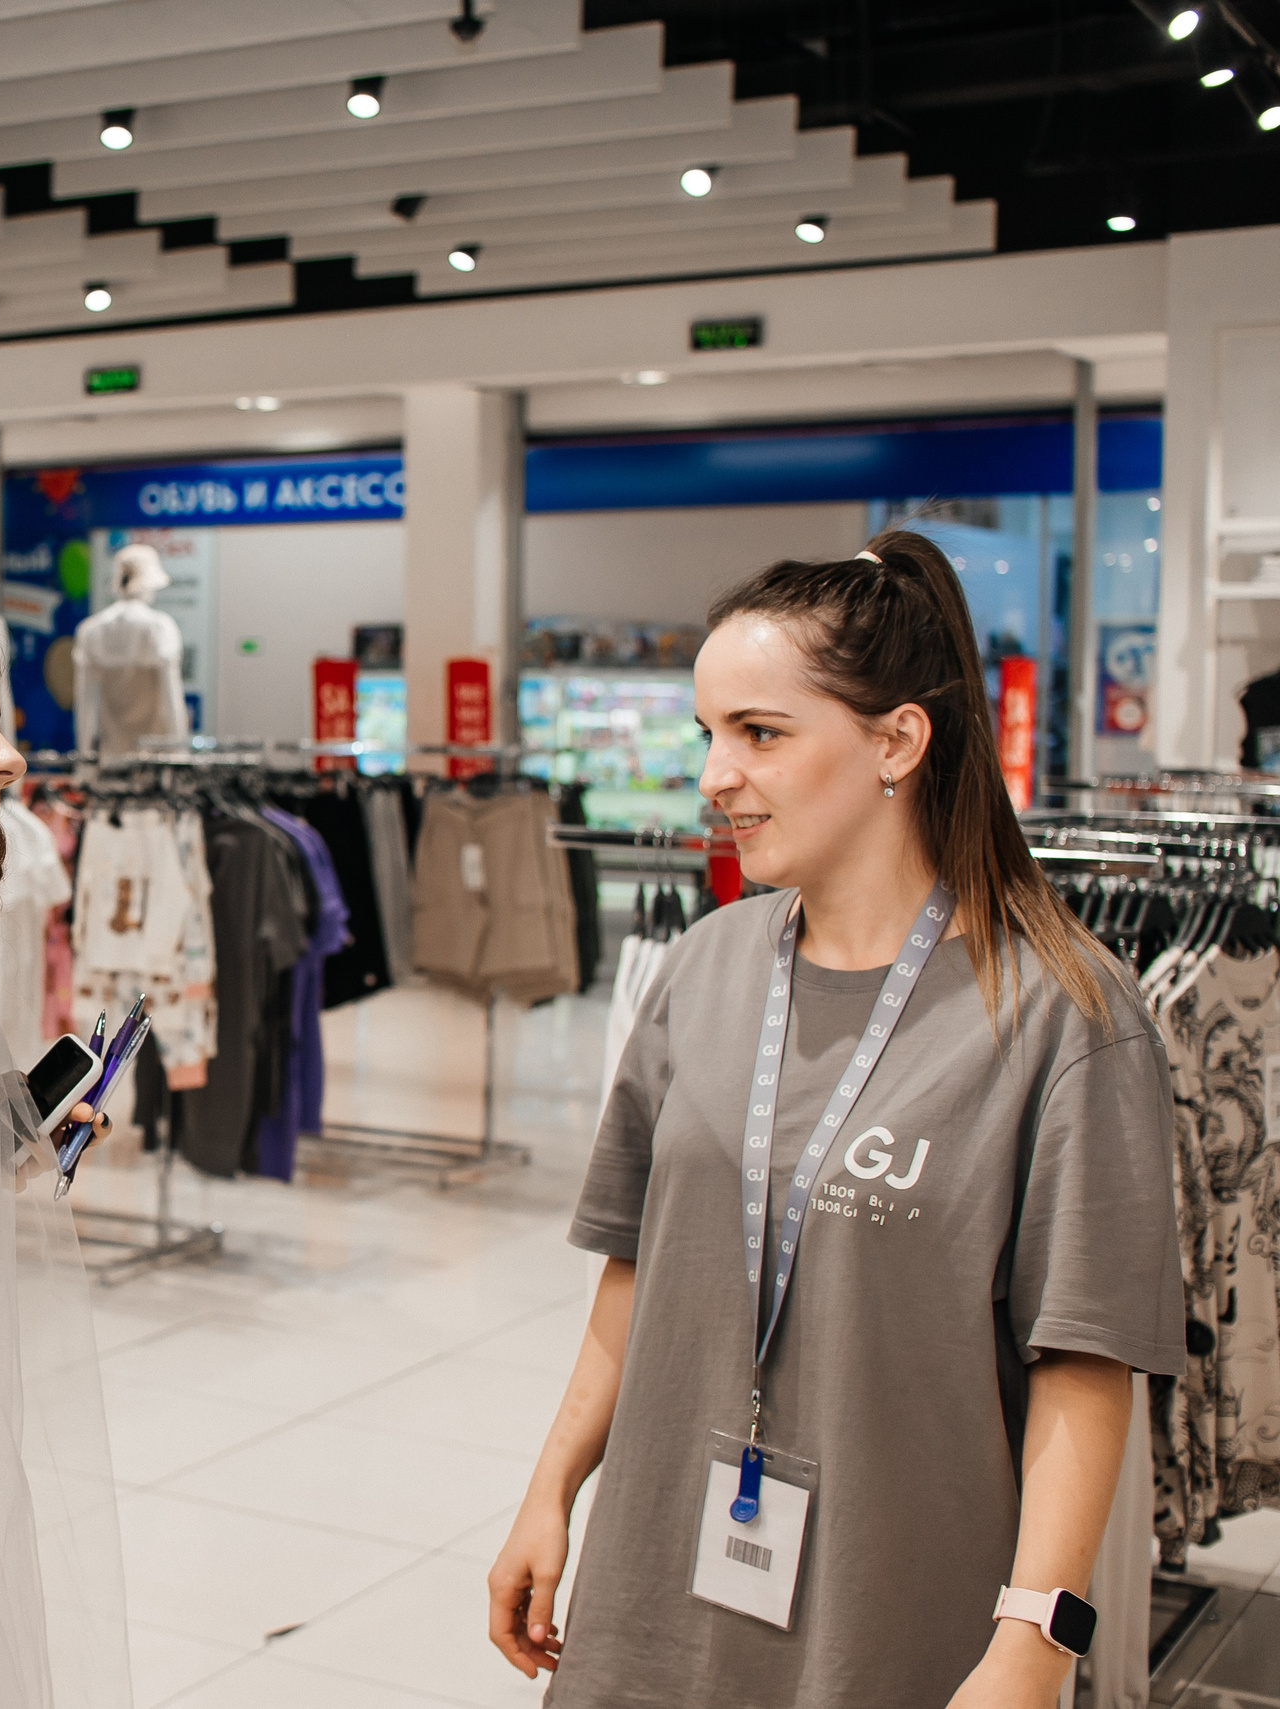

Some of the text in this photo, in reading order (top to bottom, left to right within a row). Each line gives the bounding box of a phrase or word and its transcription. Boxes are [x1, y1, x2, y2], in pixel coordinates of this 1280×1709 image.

[139, 480, 238, 516] ОБУВЬ
[243, 479, 268, 511] И
[926, 907, 944, 921] GJ
[783, 928, 795, 941] GJ
[911, 934, 930, 948] GJ
[776, 955, 790, 968] GJ
[897, 963, 916, 977] GJ
[772, 984, 786, 997] GJ
[883, 993, 901, 1007] GJ
[767, 1014, 783, 1026] GJ
[870, 1024, 887, 1038] GJ
[763, 1044, 779, 1056] GJ
[856, 1055, 872, 1068] GJ
[758, 1074, 775, 1085] GJ
[840, 1085, 857, 1098] GJ
[753, 1104, 771, 1116] GJ
[824, 1114, 841, 1127] GJ
[749, 1136, 767, 1148] GJ
[808, 1144, 824, 1157] GJ
[844, 1126, 930, 1190] GJ
[747, 1169, 765, 1181] GJ
[795, 1175, 810, 1189] GJ
[747, 1203, 762, 1215] GJ
[811, 1198, 841, 1214] ТВОЯ
[787, 1208, 800, 1222] GJ
[748, 1236, 761, 1248] GJ
[782, 1240, 793, 1254] GJ
[748, 1270, 758, 1282] GJ
[776, 1273, 786, 1287] GJ
